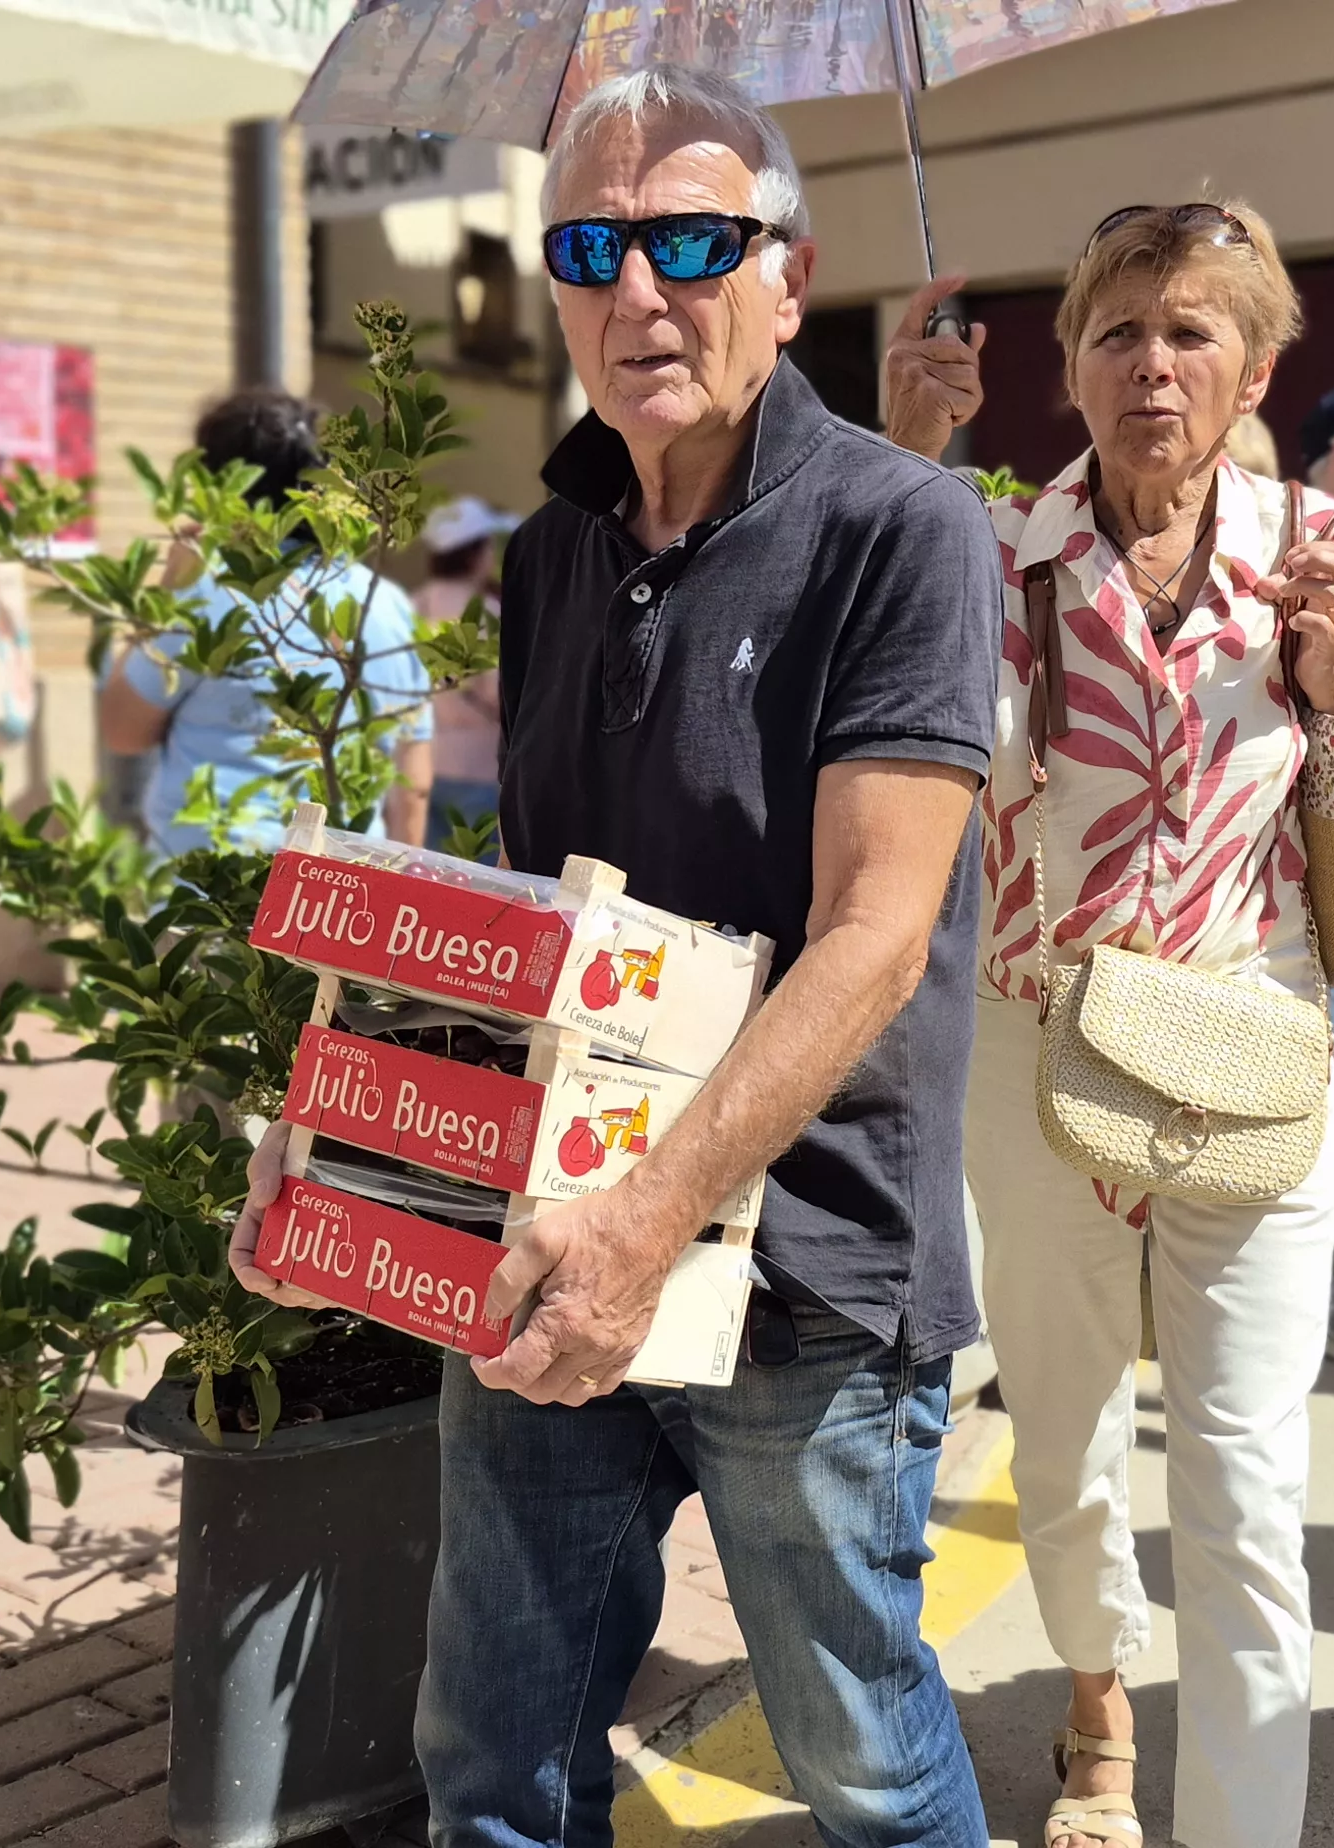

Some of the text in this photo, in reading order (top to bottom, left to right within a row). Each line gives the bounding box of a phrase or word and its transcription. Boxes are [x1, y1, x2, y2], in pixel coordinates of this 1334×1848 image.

[297, 859, 361, 889] Cerezas
[271, 881, 375, 946] Julio
[386, 904, 519, 983] Buesa
[436, 972, 466, 989] BOLEA
[569, 1007, 645, 1048] Cereza de Bolea
[318, 1033, 370, 1066] Cerezas
[573, 1068, 612, 1084] Asociación
[619, 1075, 661, 1092] Productores
[298, 1056, 383, 1122] Julio
[392, 1079, 500, 1159] Buesa
[433, 1148, 457, 1165] BOLEA
[292, 1185, 345, 1220] Cerezas
[550, 1177, 589, 1196] Cereza
[270, 1208, 477, 1325] Julio Buesa
[407, 1309, 433, 1329] BOLEA
[433, 1321, 470, 1342] (HUECA)
